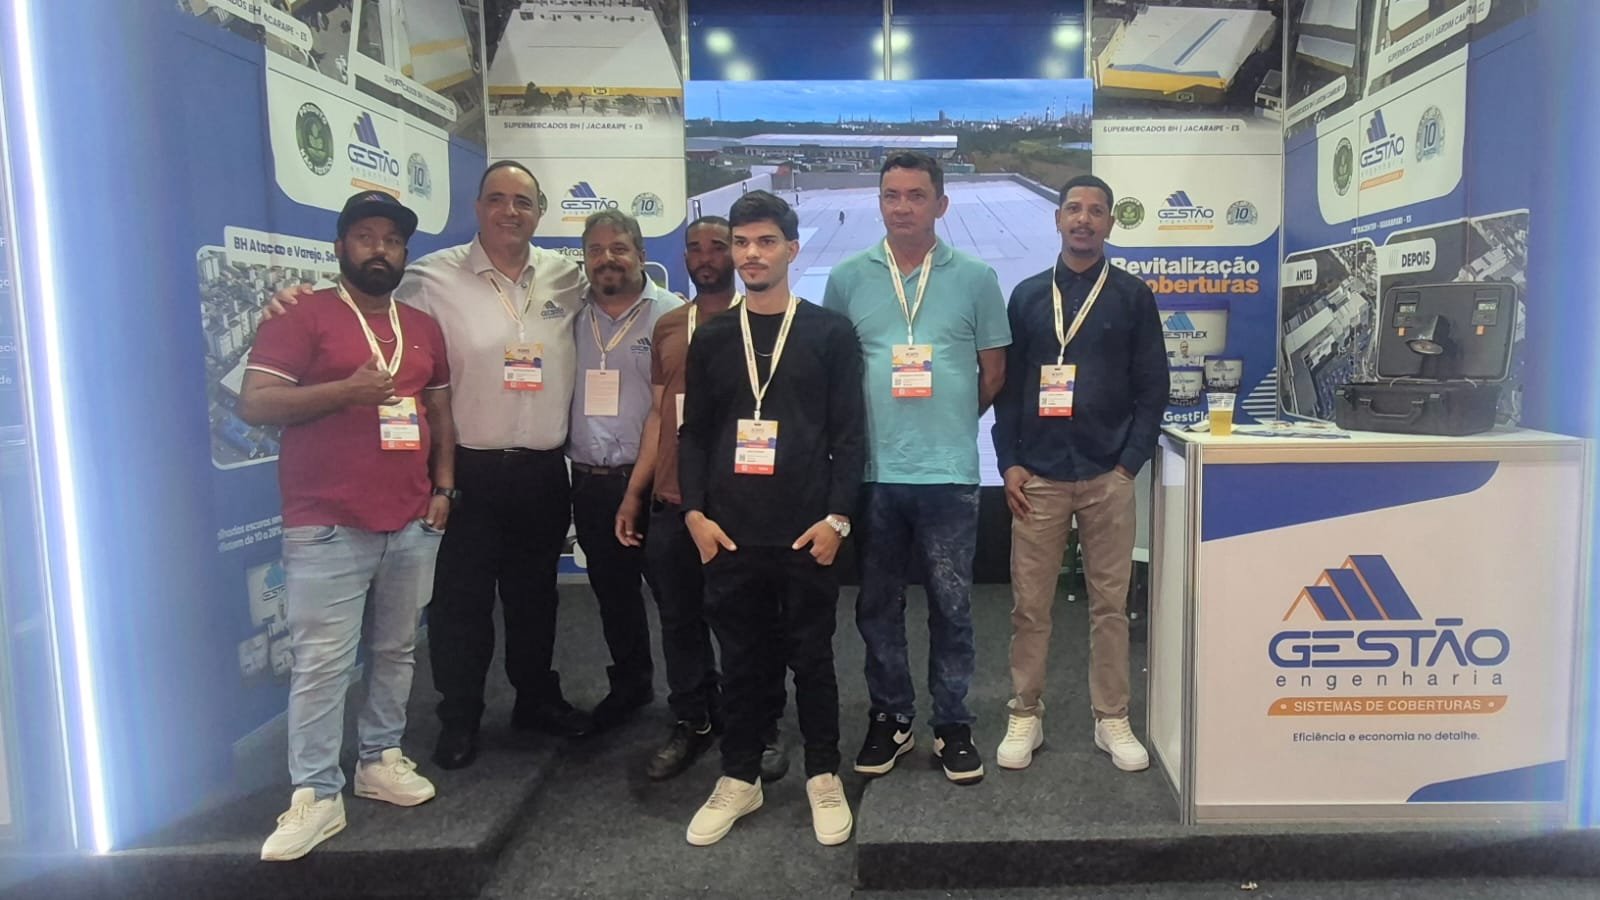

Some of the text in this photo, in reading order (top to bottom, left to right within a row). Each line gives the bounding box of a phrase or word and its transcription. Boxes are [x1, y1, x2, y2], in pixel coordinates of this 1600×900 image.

[1423, 121, 1437, 149] 10
[1360, 133, 1405, 168] GESTÃO
[347, 143, 400, 177] GESTÃO
[414, 165, 425, 187] 10
[561, 197, 619, 210] GESTÃO
[641, 199, 654, 211] 10
[1157, 205, 1214, 219] GESTÃO
[1235, 207, 1249, 220] 10
[234, 236, 248, 251] BH
[287, 246, 293, 256] e
[1110, 255, 1260, 279] Revitalização
[1401, 251, 1431, 268] DEPOIS
[1295, 269, 1313, 281] ANTES
[1148, 276, 1260, 294] oberturas
[1163, 330, 1208, 339] ESTFLEX
[1268, 617, 1511, 669] GESTÃO
[1275, 669, 1503, 690] engenharia
[1294, 700, 1482, 713] SISTEMAS DE COBERTURAS
[1293, 731, 1480, 743] Eficiência e economia no detalhe.
